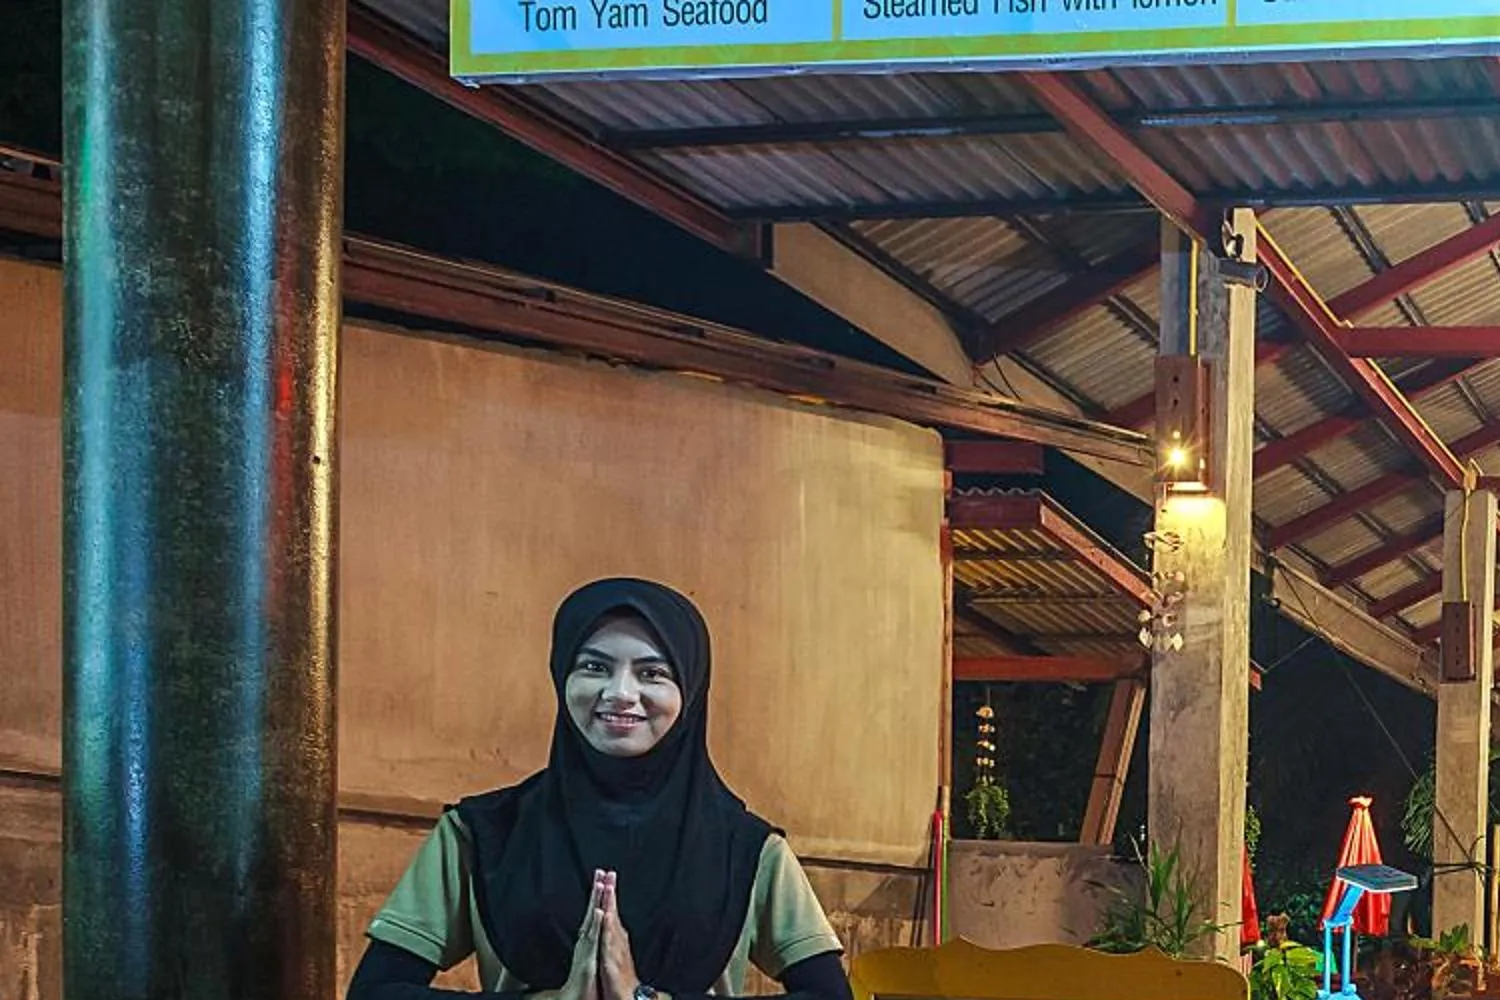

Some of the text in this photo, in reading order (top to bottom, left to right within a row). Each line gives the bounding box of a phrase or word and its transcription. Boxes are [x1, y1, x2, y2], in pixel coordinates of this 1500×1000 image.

[518, 0, 768, 32] Tom Yam Seafood
